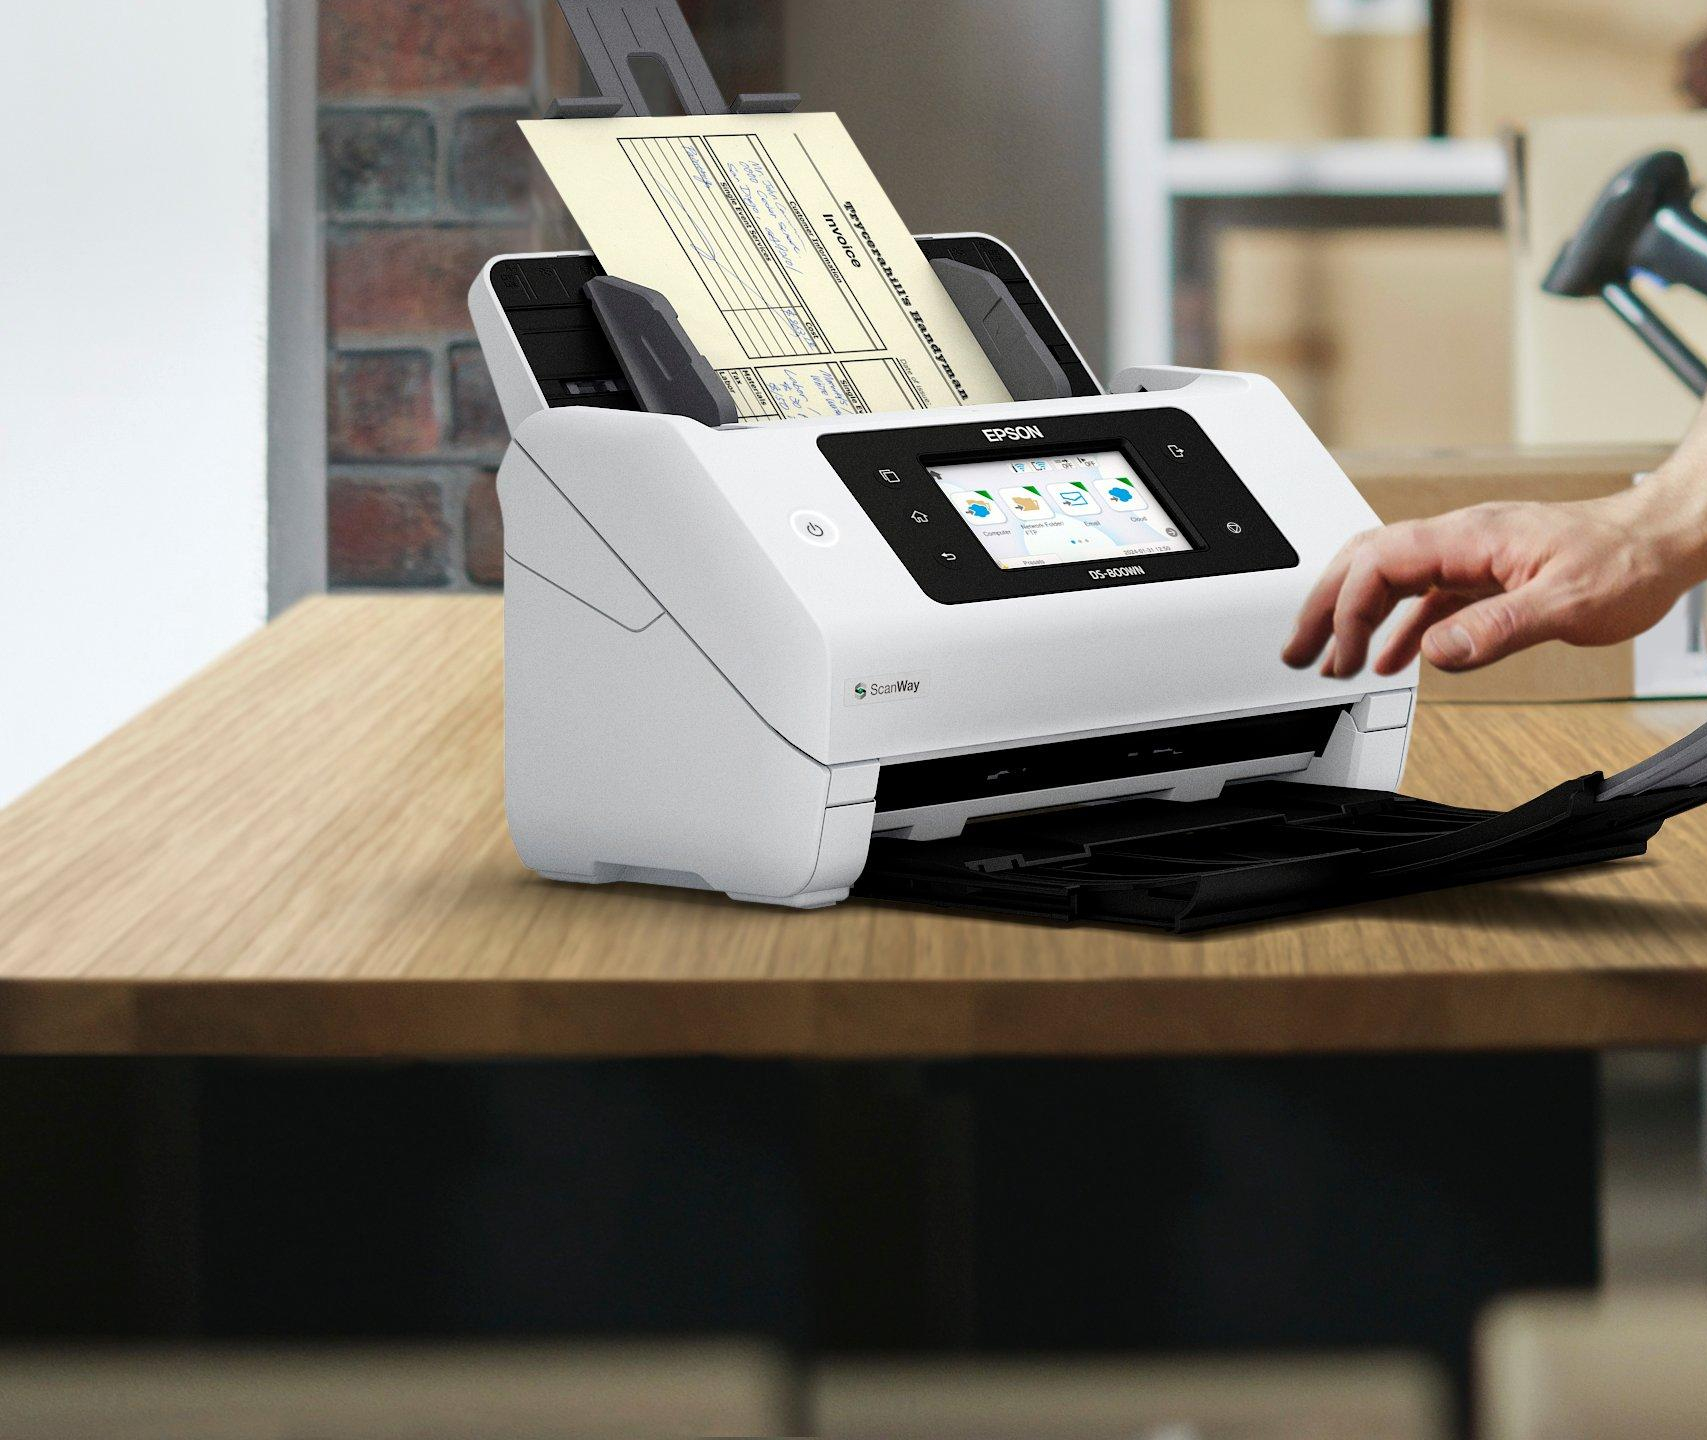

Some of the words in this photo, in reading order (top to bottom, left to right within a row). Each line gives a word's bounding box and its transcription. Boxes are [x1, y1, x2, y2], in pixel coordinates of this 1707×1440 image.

[718, 181, 738, 205] Single
[734, 206, 751, 228] Event
[749, 229, 772, 262] Services
[789, 200, 814, 236] Customer
[812, 238, 843, 283] Information
[822, 213, 862, 269] Invoice
[805, 321, 819, 339] Cost
[910, 310, 969, 400] Handyman
[719, 371, 736, 394] Labor
[731, 371, 743, 385] Tax
[743, 370, 767, 406] Materials
[838, 379, 858, 403] Single
[981, 425, 1044, 442] EPSON
[982, 529, 1012, 537] Computer
[1088, 565, 1146, 580] DS-800WN
[870, 680, 920, 696] ScanWay
